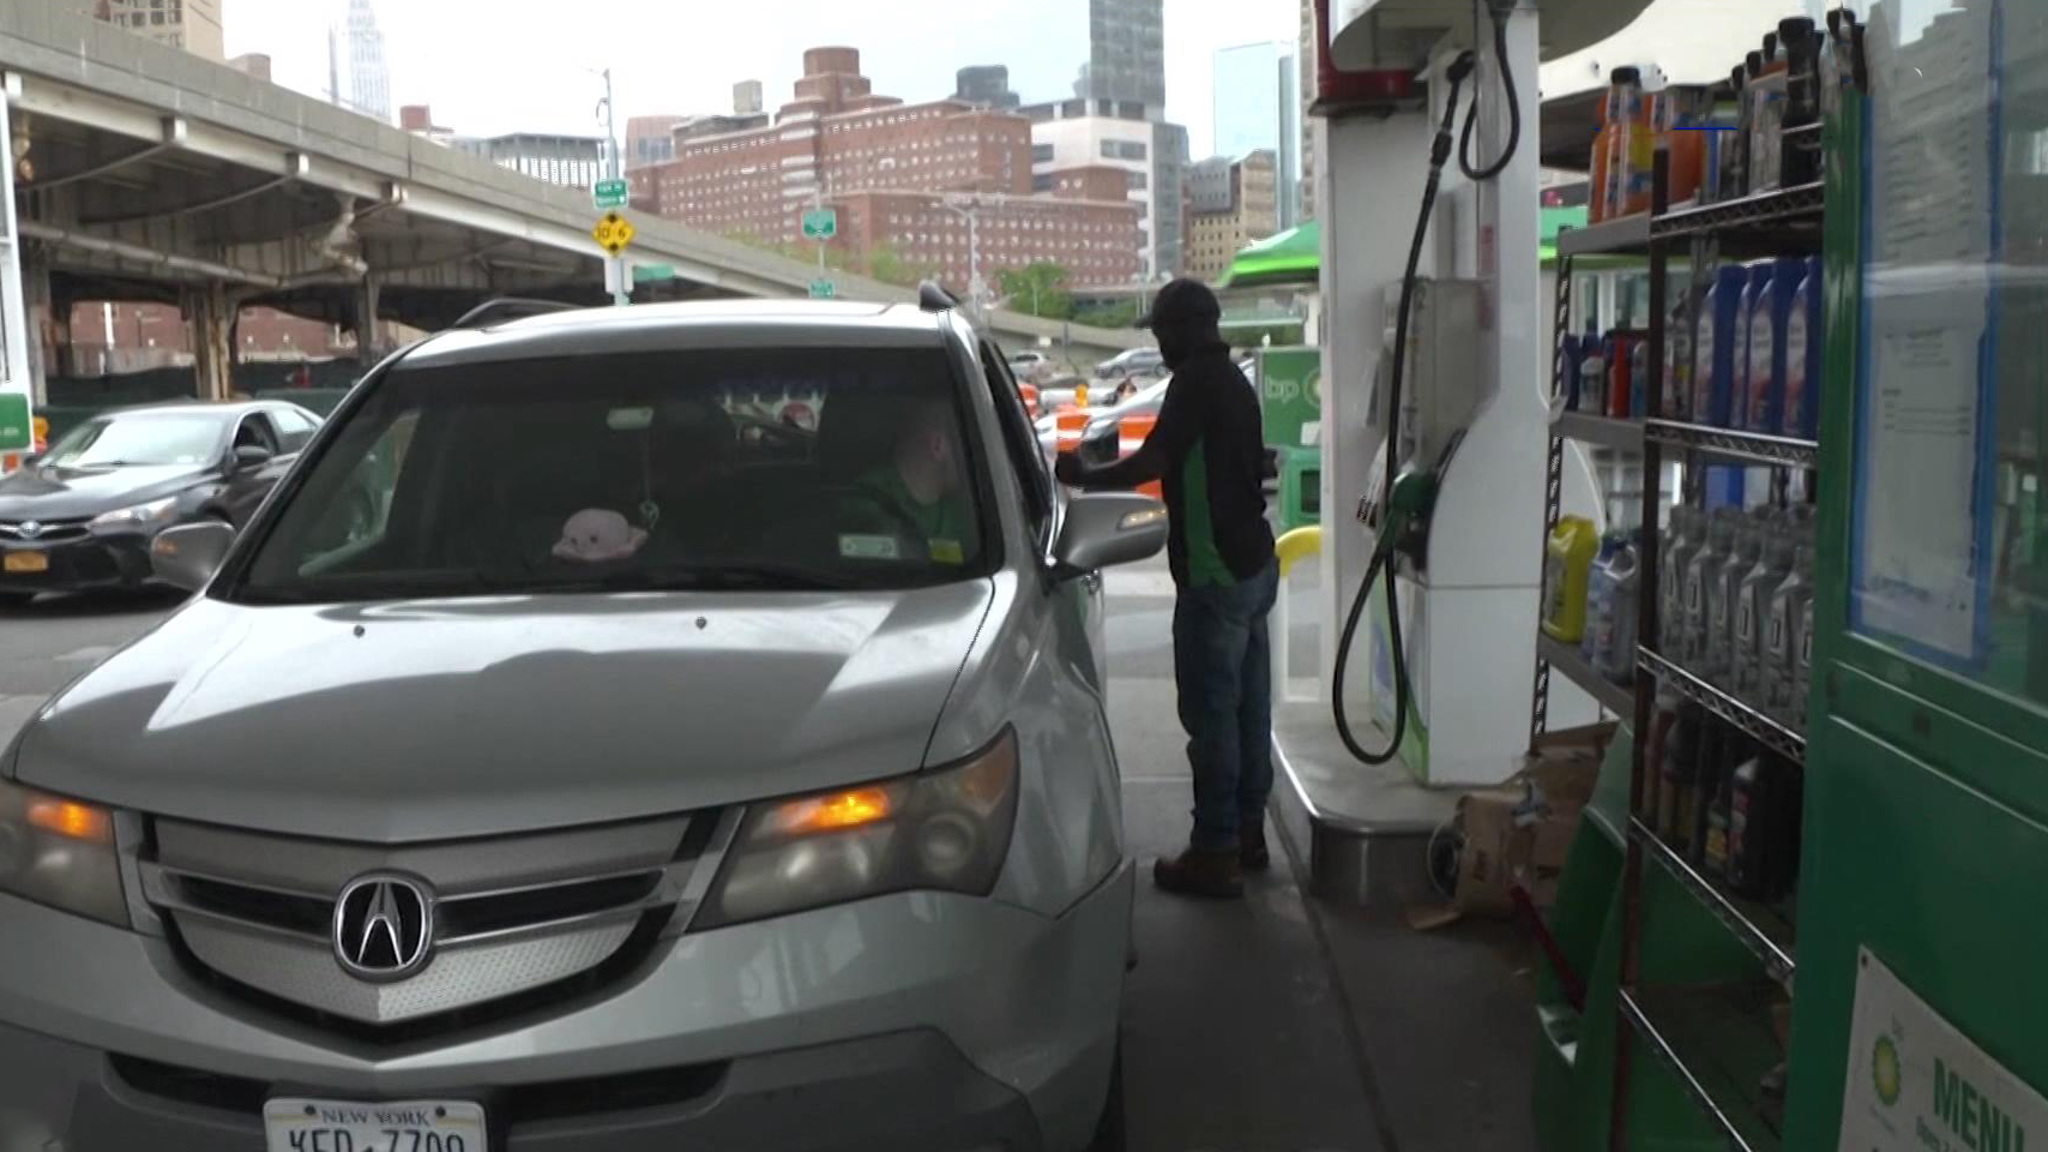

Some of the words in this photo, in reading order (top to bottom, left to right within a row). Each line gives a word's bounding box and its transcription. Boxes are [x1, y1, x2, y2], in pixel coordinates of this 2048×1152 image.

[1265, 375, 1300, 404] bp
[321, 1108, 367, 1125] NEW
[375, 1109, 431, 1128] YORK
[1933, 1056, 2025, 1152] MENU
